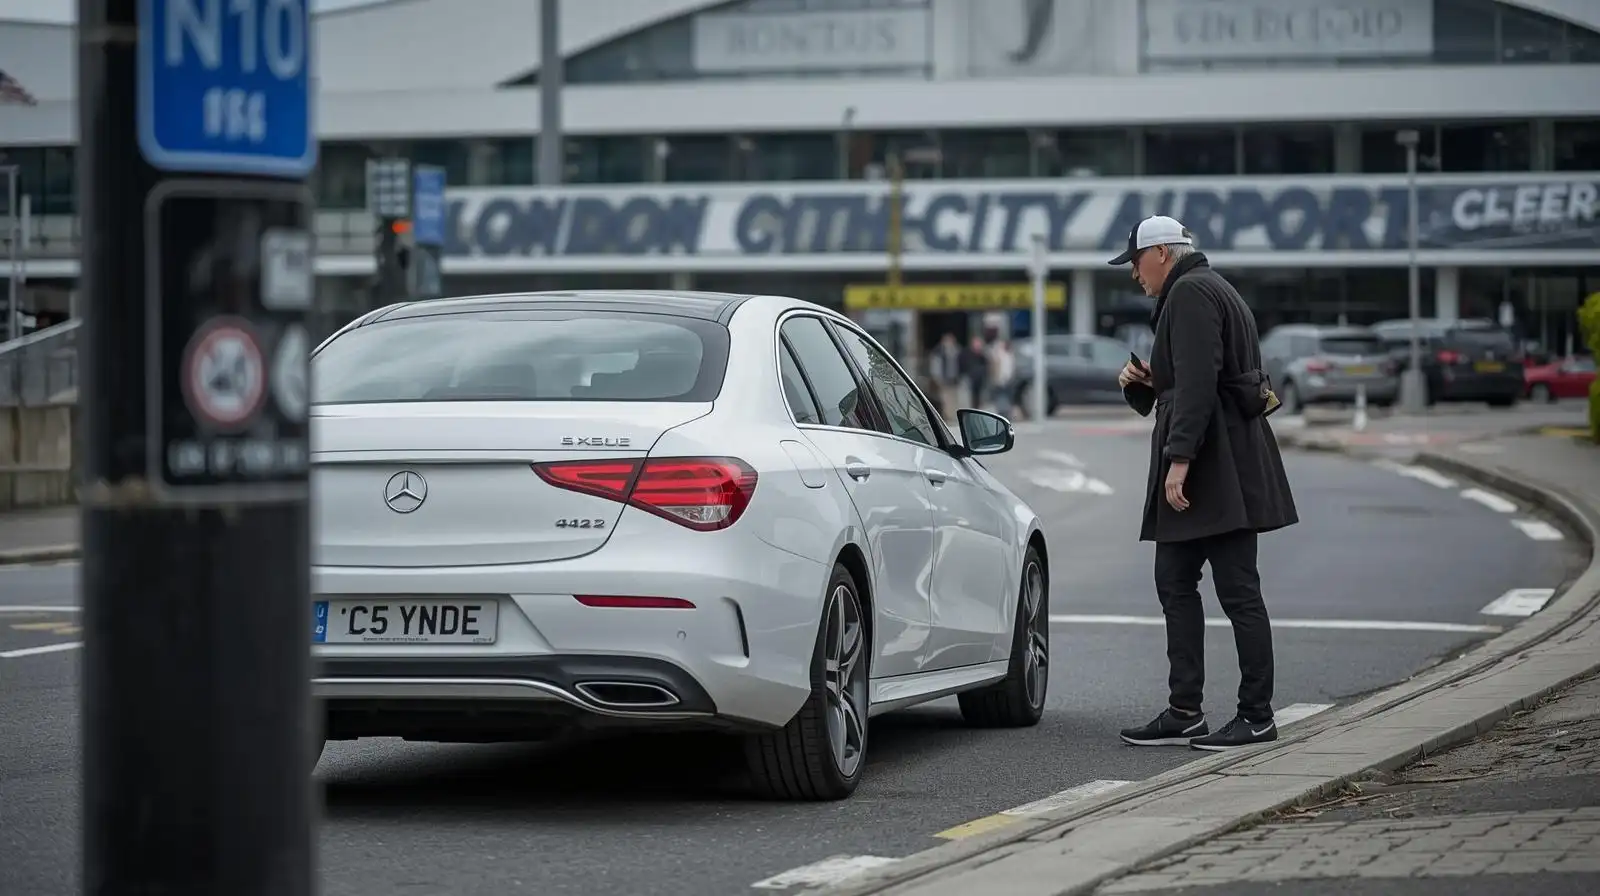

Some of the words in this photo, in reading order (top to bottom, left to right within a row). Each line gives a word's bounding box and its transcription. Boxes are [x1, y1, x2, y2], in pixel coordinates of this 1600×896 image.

[163, 0, 303, 80] N10
[441, 195, 706, 257] LONDON
[400, 605, 482, 636] YNDE
